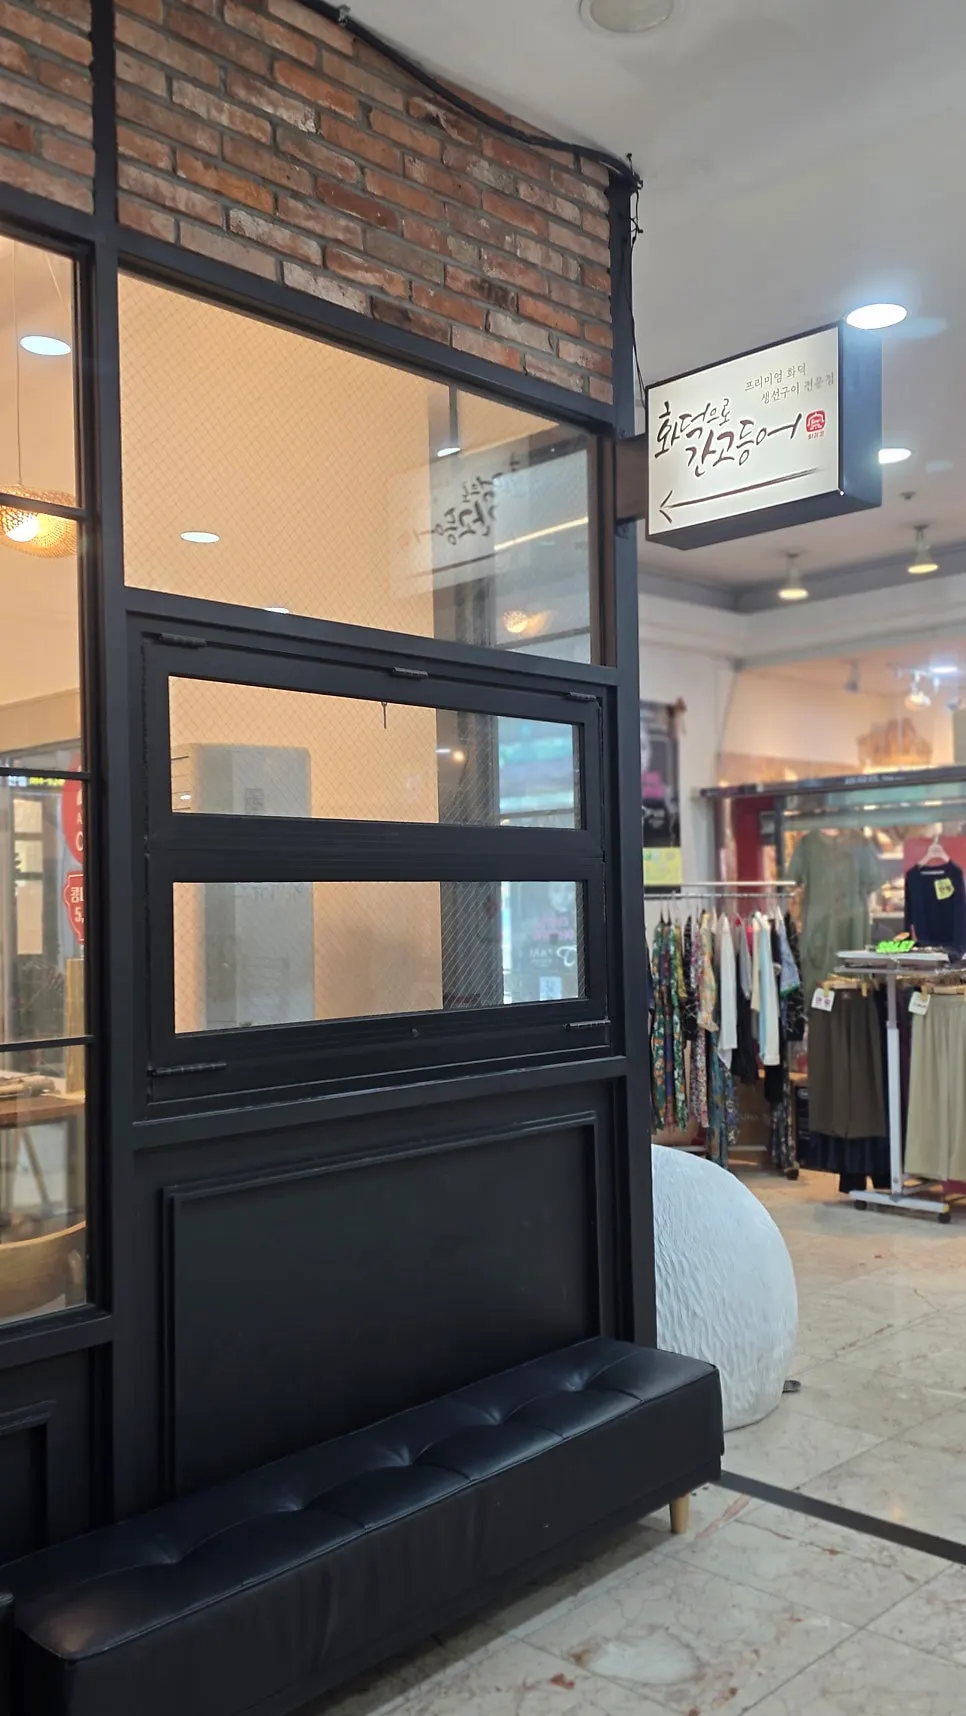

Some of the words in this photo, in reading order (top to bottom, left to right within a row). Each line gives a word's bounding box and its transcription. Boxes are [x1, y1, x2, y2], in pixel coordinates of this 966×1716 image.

[744, 370, 783, 391] 프리미엄
[786, 362, 806, 378] 화덕
[761, 381, 800, 404] 생선구이
[804, 372, 834, 391] 전문점
[654, 398, 731, 459] 화덕으로
[685, 412, 803, 478] 간고등어
